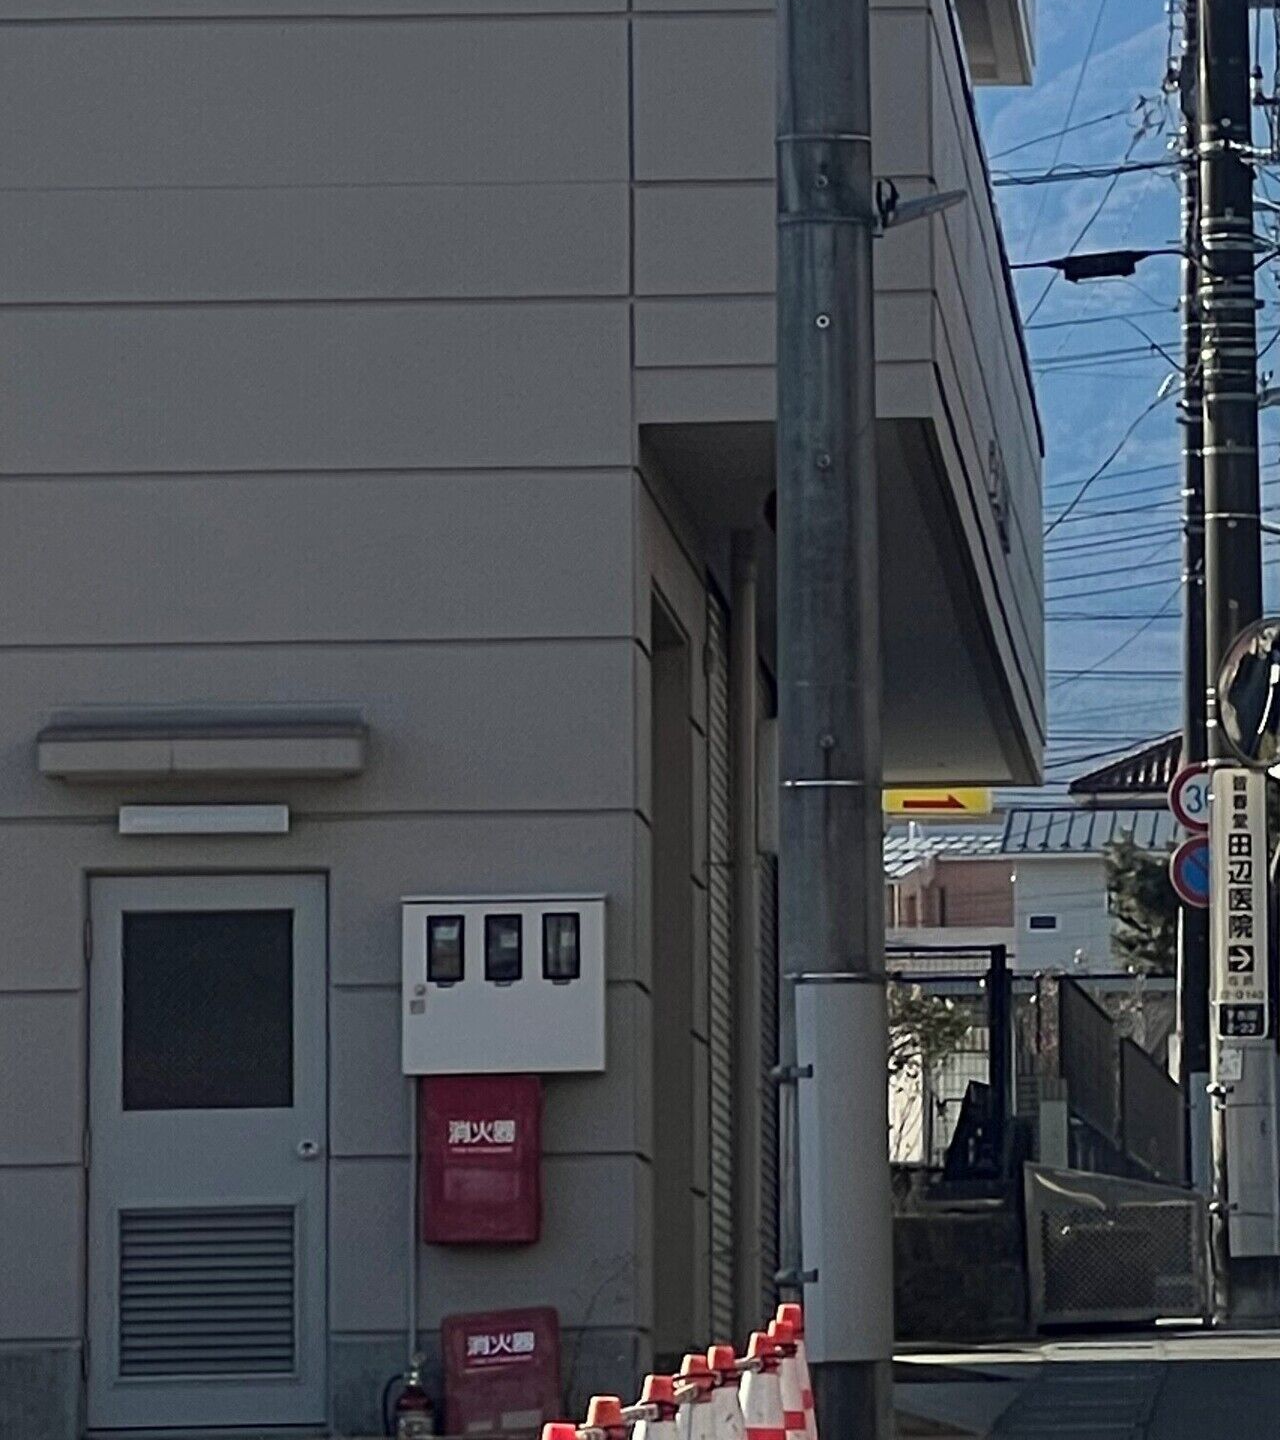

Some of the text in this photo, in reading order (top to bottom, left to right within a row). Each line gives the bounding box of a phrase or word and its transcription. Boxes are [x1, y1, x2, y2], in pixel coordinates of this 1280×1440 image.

[1228, 833, 1252, 939] 田辺医院
[448, 1119, 516, 1144] 消火器
[467, 1330, 535, 1357] 消火器
